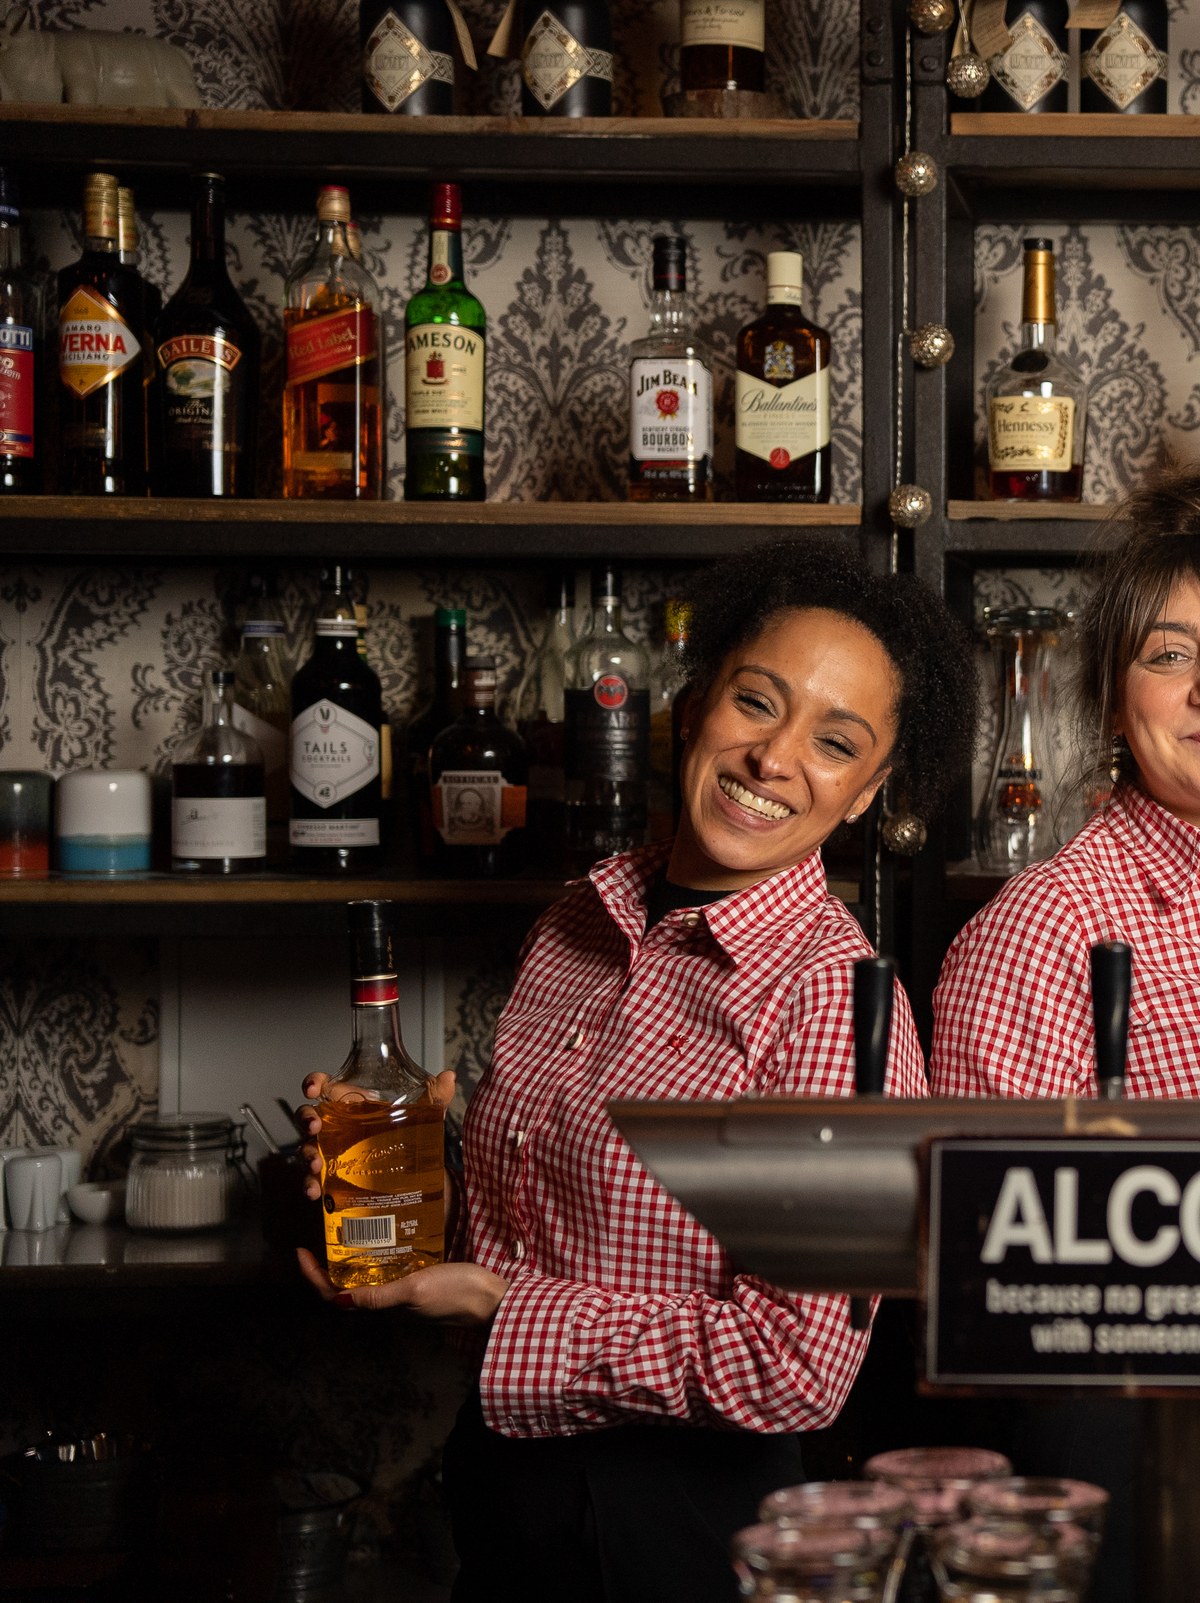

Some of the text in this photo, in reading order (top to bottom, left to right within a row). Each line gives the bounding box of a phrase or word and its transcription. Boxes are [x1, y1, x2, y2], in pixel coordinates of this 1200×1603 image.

[161, 339, 234, 361] BAILES
[406, 332, 476, 355] AMESON
[637, 373, 660, 397] JIM
[997, 419, 1056, 435] Hennessy
[304, 741, 347, 754] TAILS
[986, 1278, 1101, 1314] because
[1103, 1284, 1143, 1315] no
[1031, 1318, 1092, 1353] with
